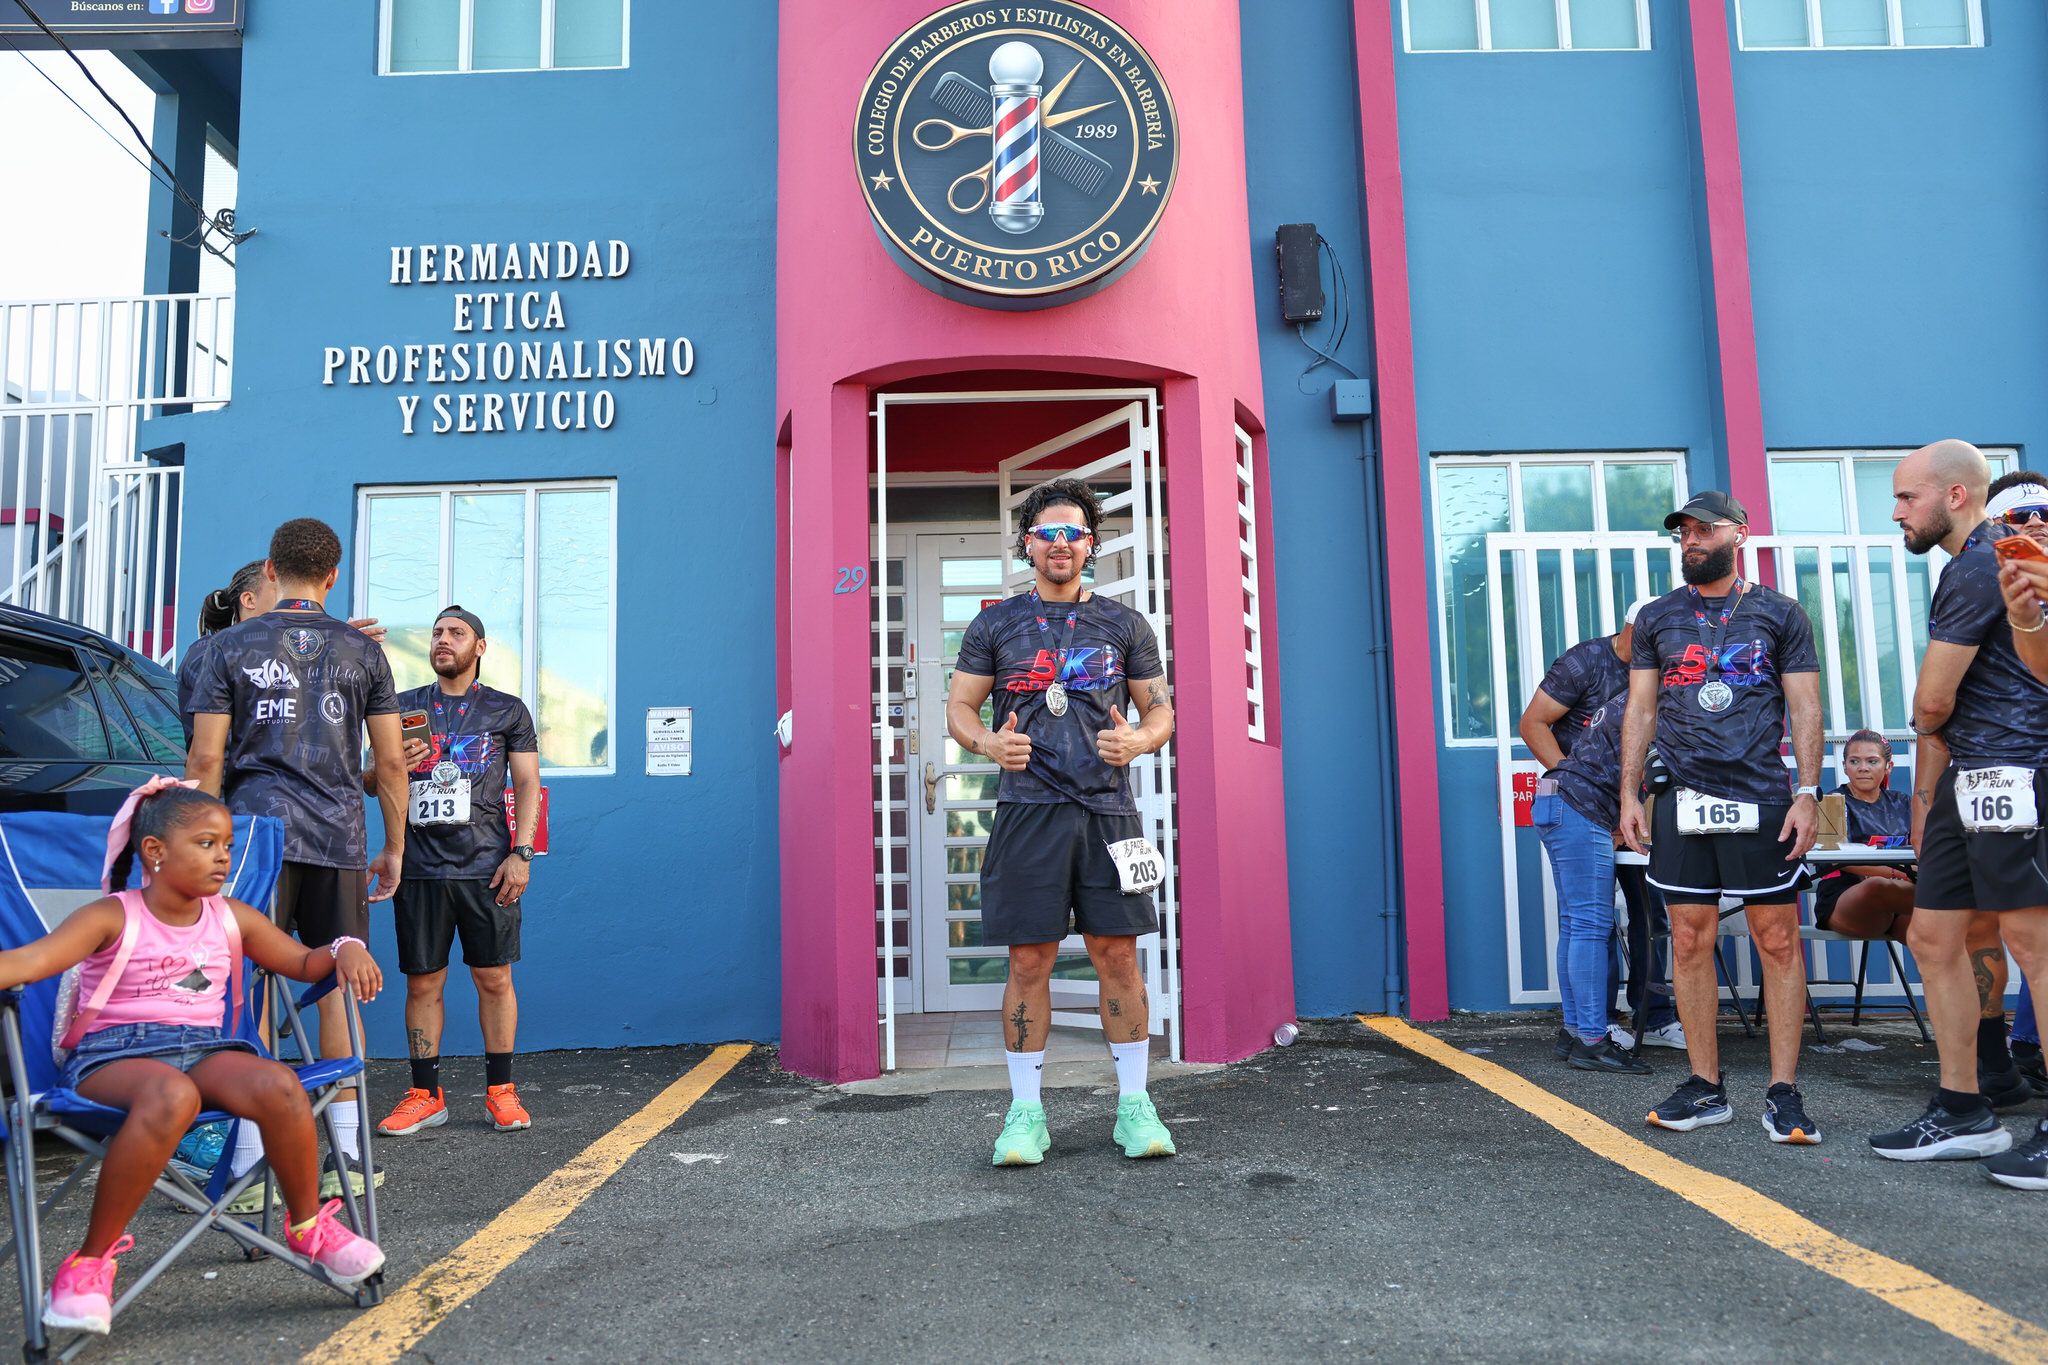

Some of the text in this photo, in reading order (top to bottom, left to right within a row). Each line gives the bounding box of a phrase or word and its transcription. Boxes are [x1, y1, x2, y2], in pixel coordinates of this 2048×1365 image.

[71, 1, 144, 11] Búscanos en:
[868, 8, 1166, 155] COLEGIO DE BARBEROS Y ESTILISTAS EN BARBERÍA
[1074, 124, 1118, 139] 1989
[389, 240, 630, 284] HERMANDAD
[909, 226, 1121, 281] PUERTO RICO
[453, 290, 566, 331] ETICA
[322, 337, 694, 385] PROFESIONALISMO
[398, 390, 615, 434] Y SERVICIO
[834, 566, 867, 594] 29
[1006, 681, 1054, 693] FADE
[1071, 678, 1109, 691] RUN
[1664, 674, 1705, 688] FADE
[256, 698, 297, 720] EME
[654, 744, 684, 752] AVISO
[1976, 770, 2004, 781] FADE
[1989, 780, 2015, 788] RUN
[419, 799, 455, 819] 213
[1695, 803, 1741, 825] 165
[1971, 795, 2014, 821] 166
[1130, 860, 1158, 884] 203
